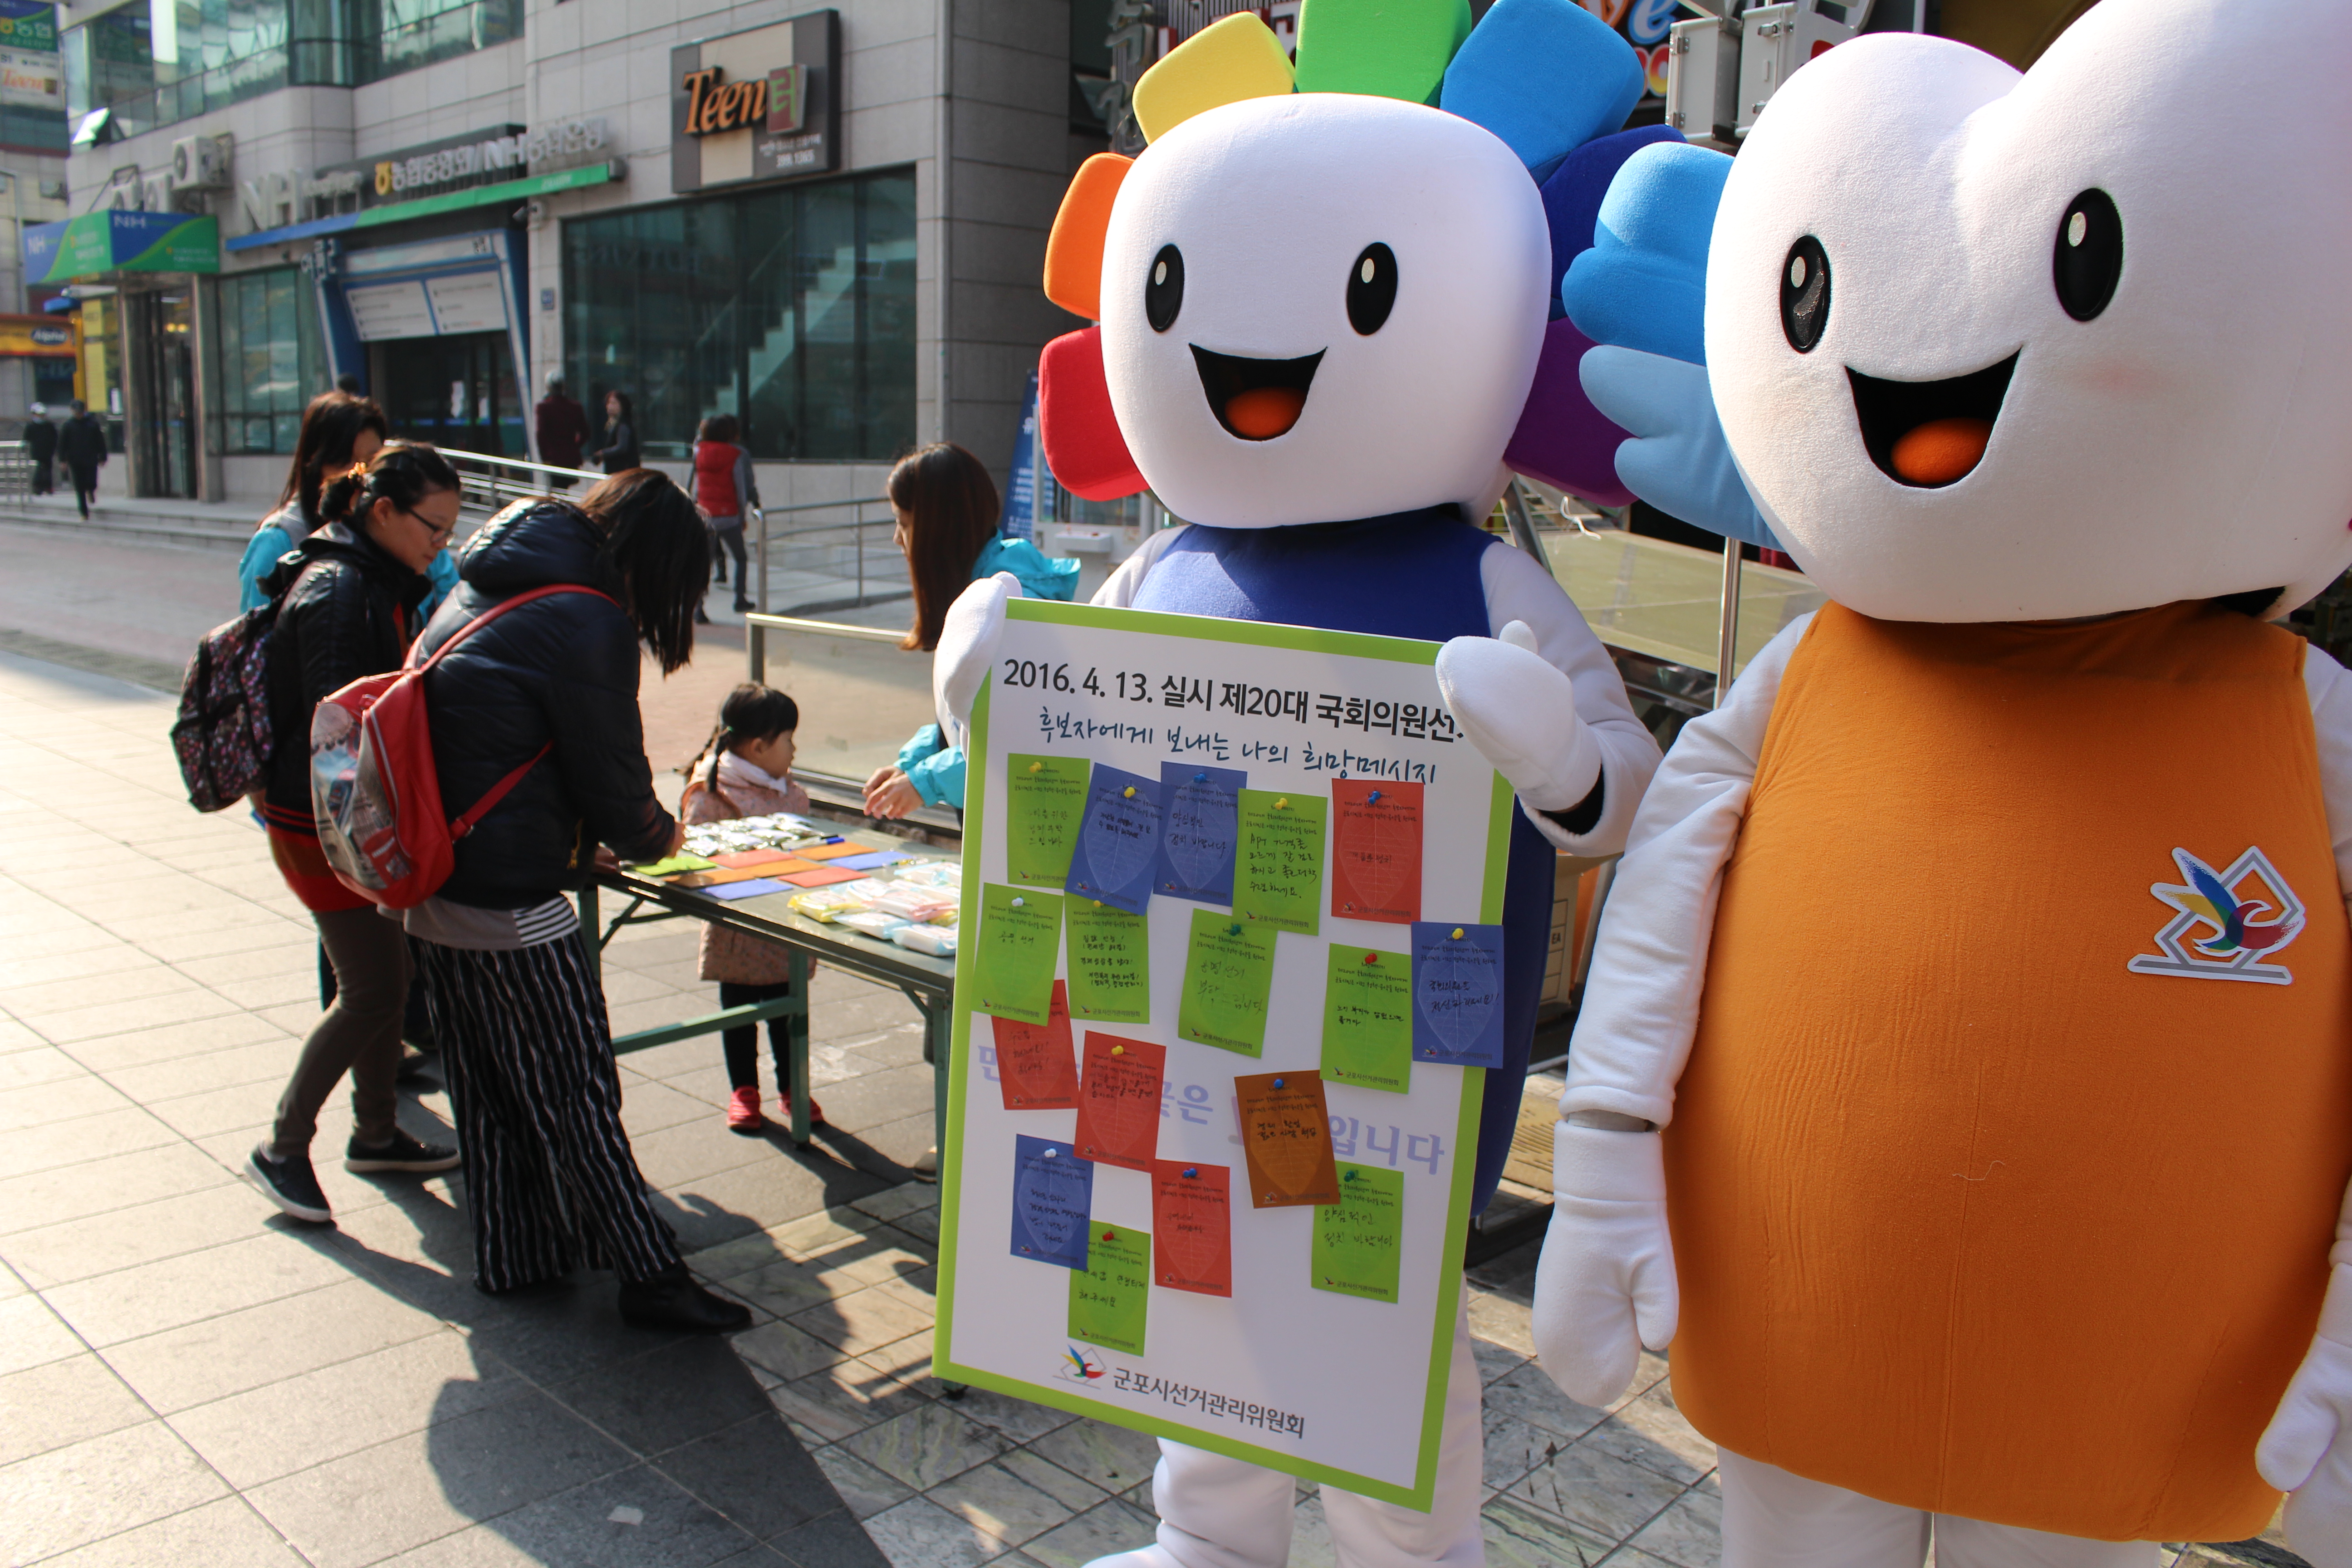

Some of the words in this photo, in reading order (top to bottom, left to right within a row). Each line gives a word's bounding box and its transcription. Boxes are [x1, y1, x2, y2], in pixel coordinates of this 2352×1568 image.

[113, 214, 146, 229] NH
[1004, 659, 1075, 694] 2016.
[1083, 667, 1105, 697] 4.
[1116, 671, 1152, 702] 13.
[1161, 675, 1212, 711] 실시
[1219, 683, 1308, 724] 제20대
[1316, 694, 1464, 743] 국회의원선
[1040, 706, 1153, 744] 후보자에게
[1168, 726, 1230, 761] 보내는
[1242, 741, 1288, 764] 나의
[1303, 741, 1436, 785] 희망메시지
[1346, 1073, 1399, 1085] 군포시선거관리위원회
[1113, 1367, 1305, 1439] 군포시선거관리위원회
